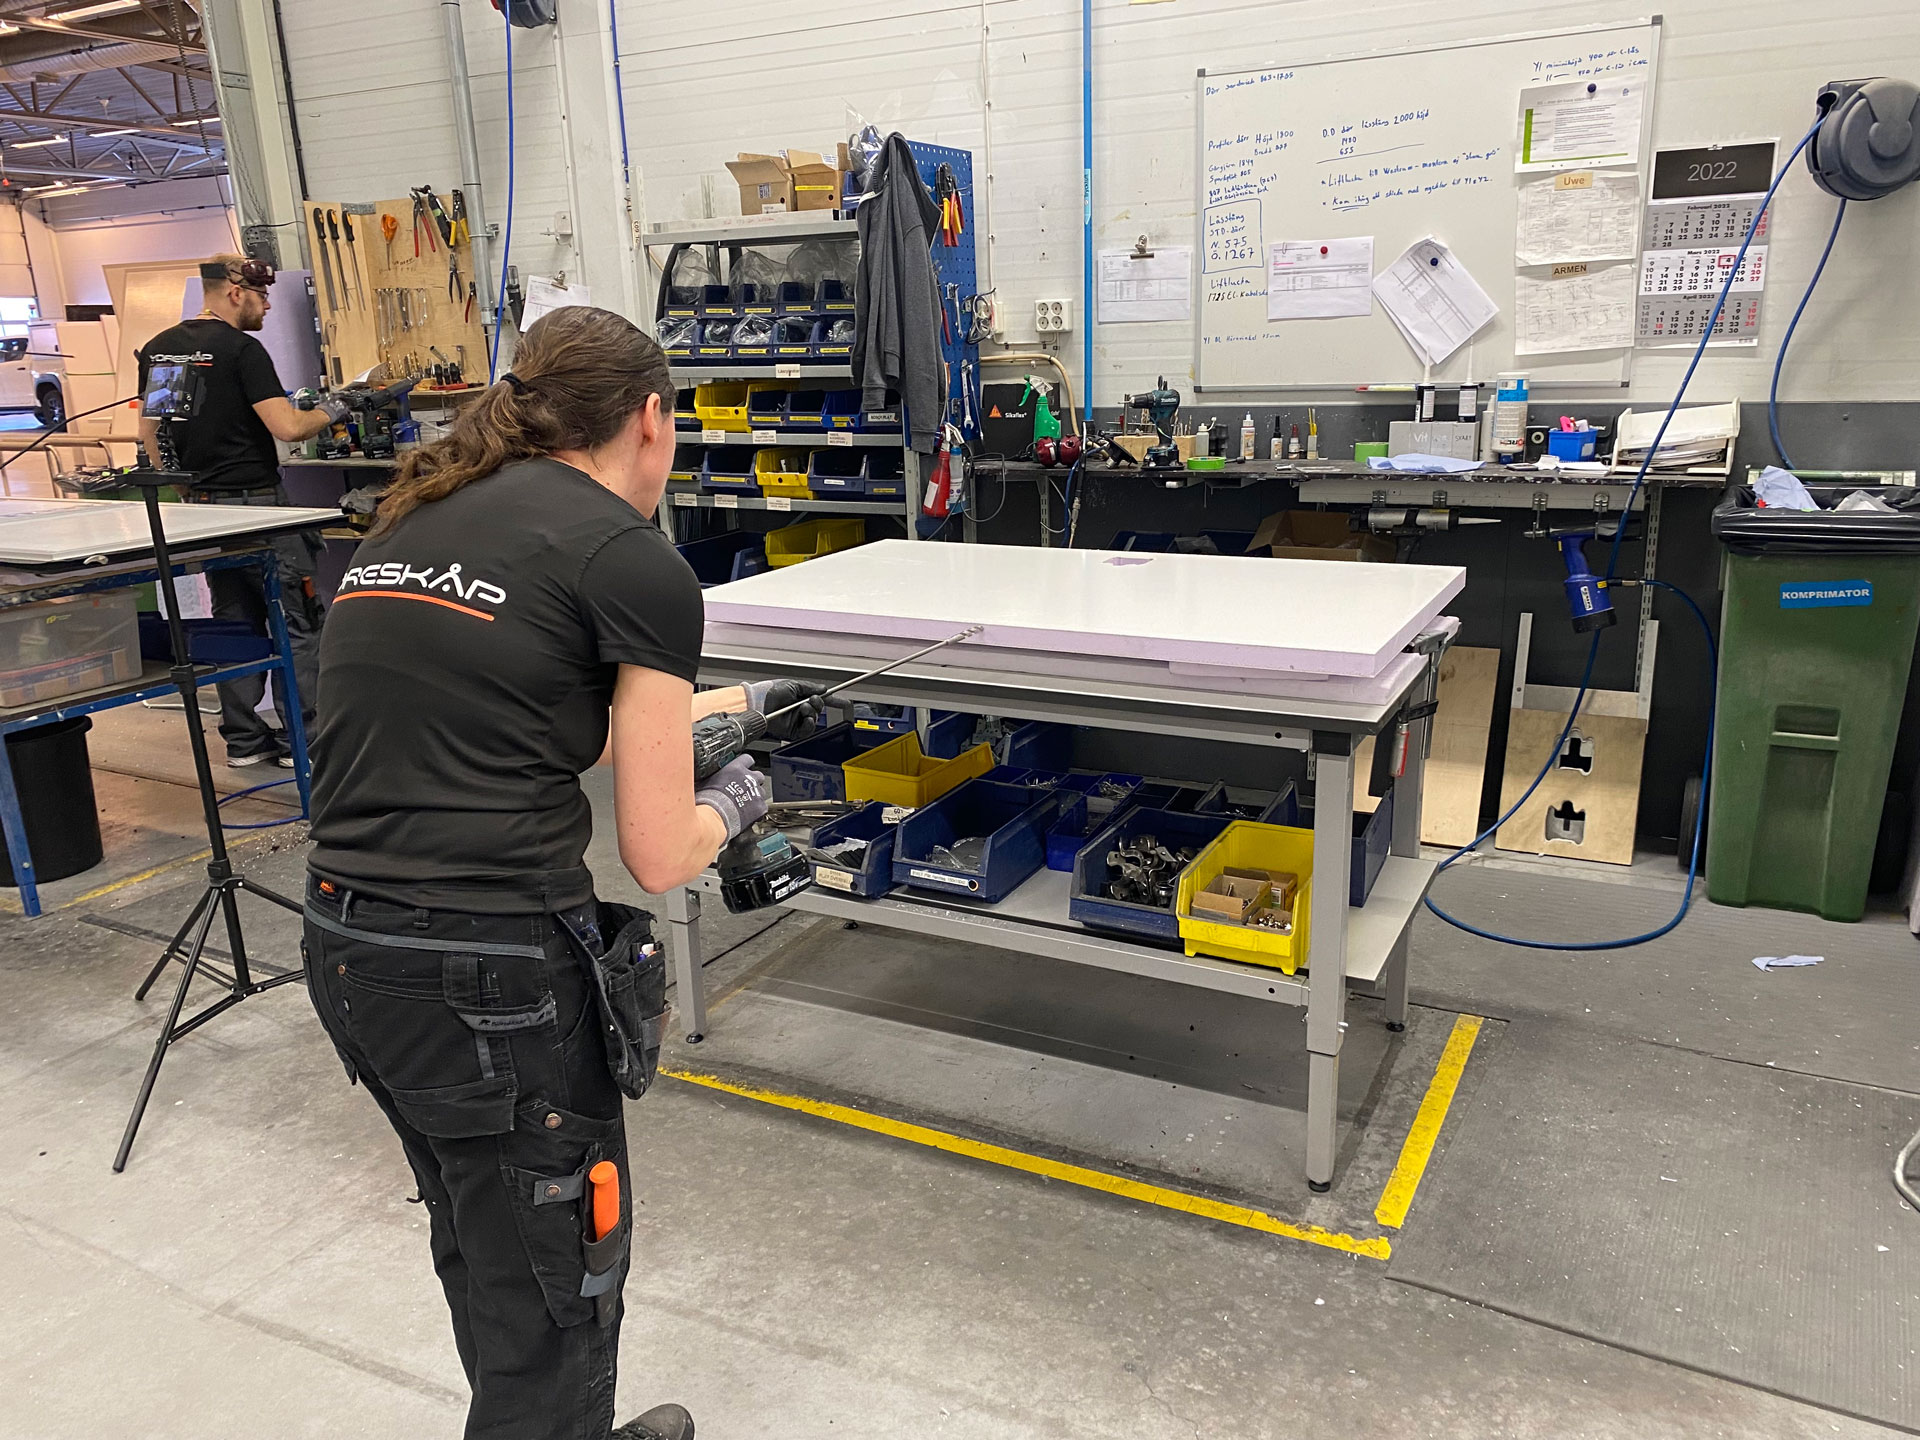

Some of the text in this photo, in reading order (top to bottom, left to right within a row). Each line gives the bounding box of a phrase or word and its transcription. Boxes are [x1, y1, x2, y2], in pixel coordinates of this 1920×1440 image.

[1687, 161, 1738, 182] 2022
[1563, 176, 1585, 186] Uwe
[1224, 236, 1248, 249] 575
[1224, 247, 1255, 260] 1267
[1553, 264, 1587, 276] ARMEN
[1782, 588, 1870, 600] KOMPRIMATOR
